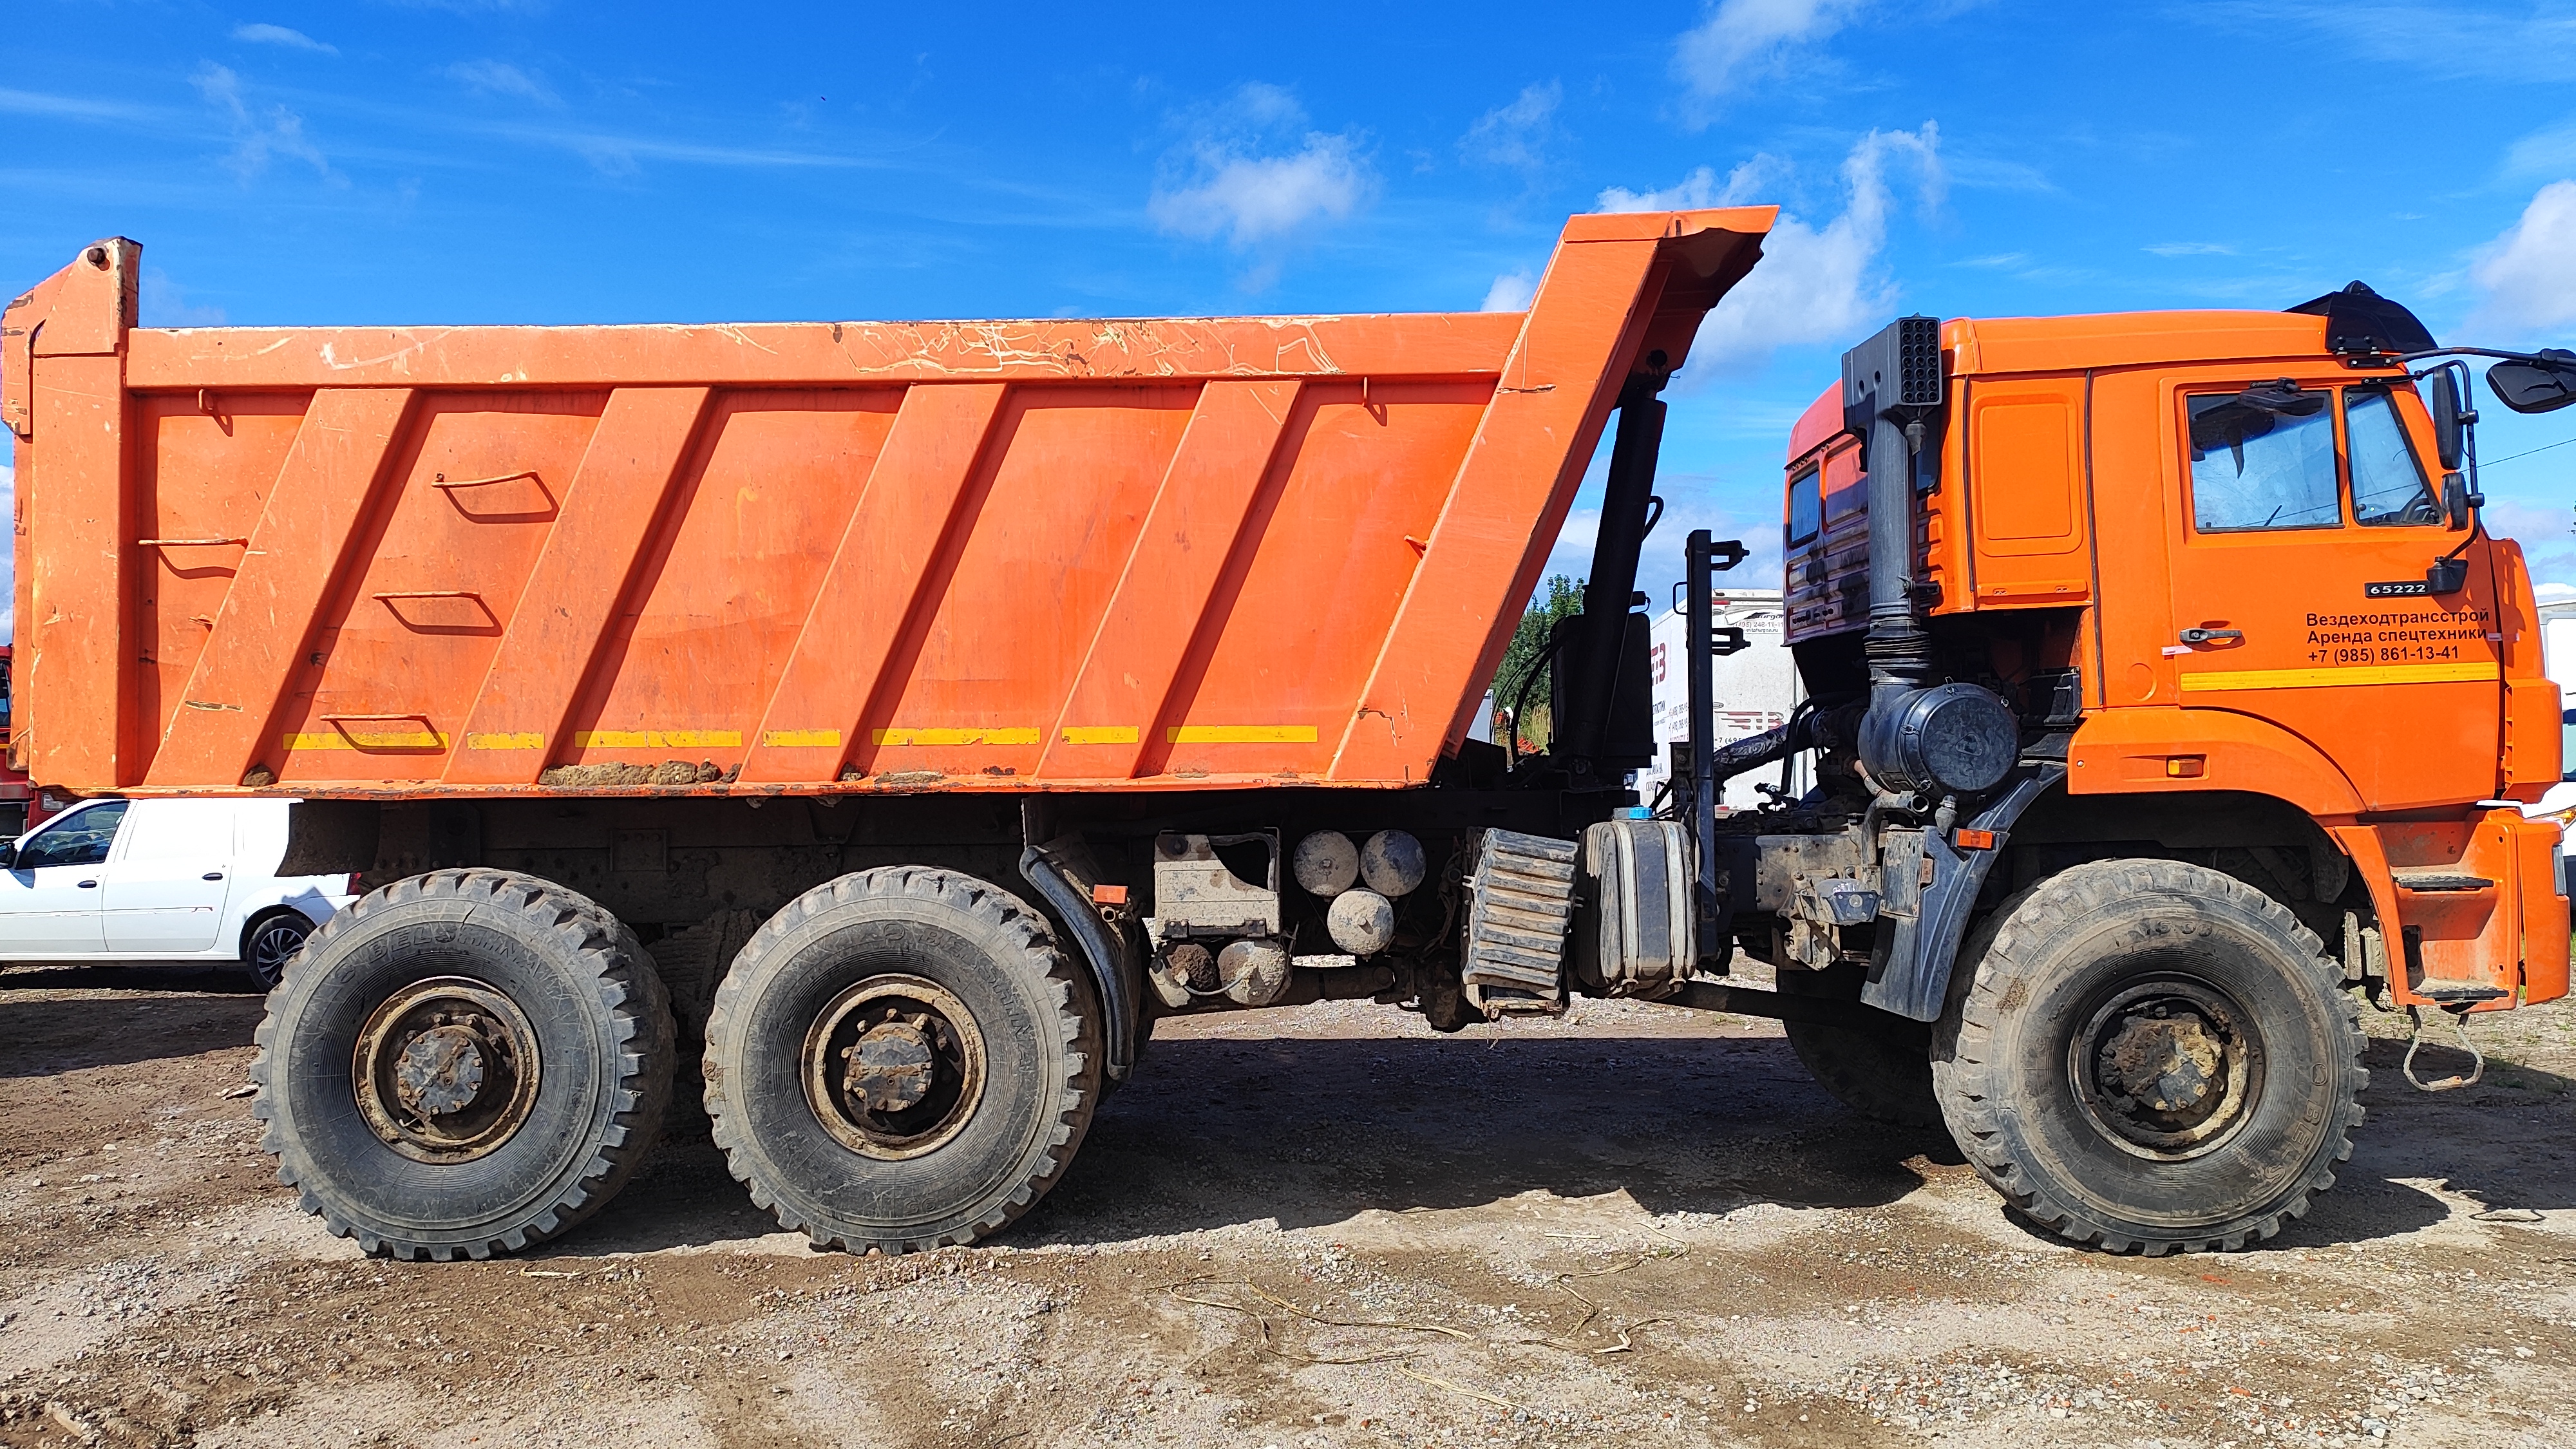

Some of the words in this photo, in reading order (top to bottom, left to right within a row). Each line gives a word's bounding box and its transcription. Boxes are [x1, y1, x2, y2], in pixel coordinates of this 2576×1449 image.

[2370, 584, 2426, 594] 65222
[2306, 607, 2490, 628] Вездеходтрансстрой
[2307, 630, 2373, 647] Аренда
[2378, 628, 2487, 643] спецтехники
[2308, 649, 2328, 663] +7
[2334, 647, 2375, 666] (985)
[2380, 645, 2459, 661] 861-13-41
